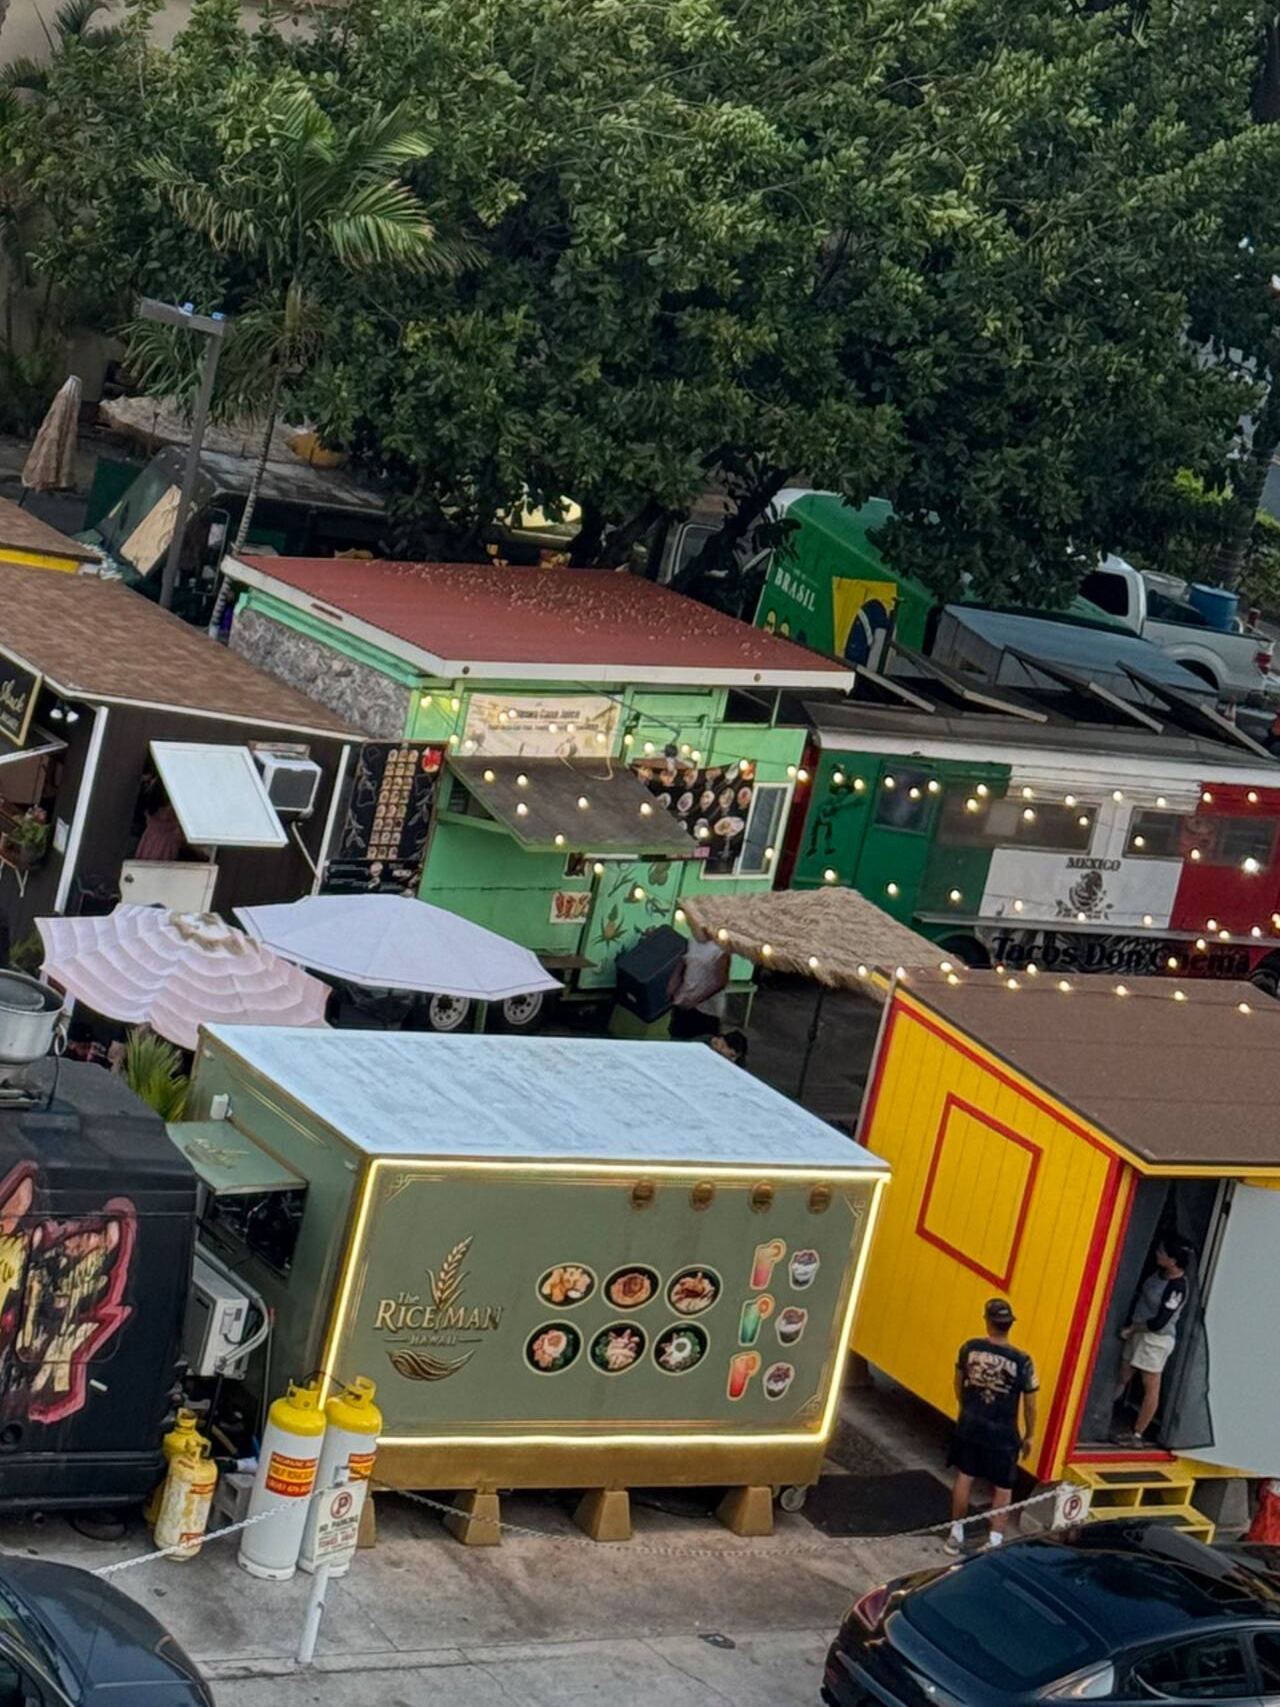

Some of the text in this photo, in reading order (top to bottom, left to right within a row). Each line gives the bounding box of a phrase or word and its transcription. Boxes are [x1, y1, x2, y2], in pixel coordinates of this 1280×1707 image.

[774, 567, 816, 613] BRASIL
[1065, 856, 1122, 872] MEXICO
[992, 935, 1076, 966] Tacos
[1084, 944, 1147, 968] Don
[398, 1291, 420, 1305] The
[409, 1334, 457, 1346] HAWAII
[331, 1514, 359, 1529] PARKING
